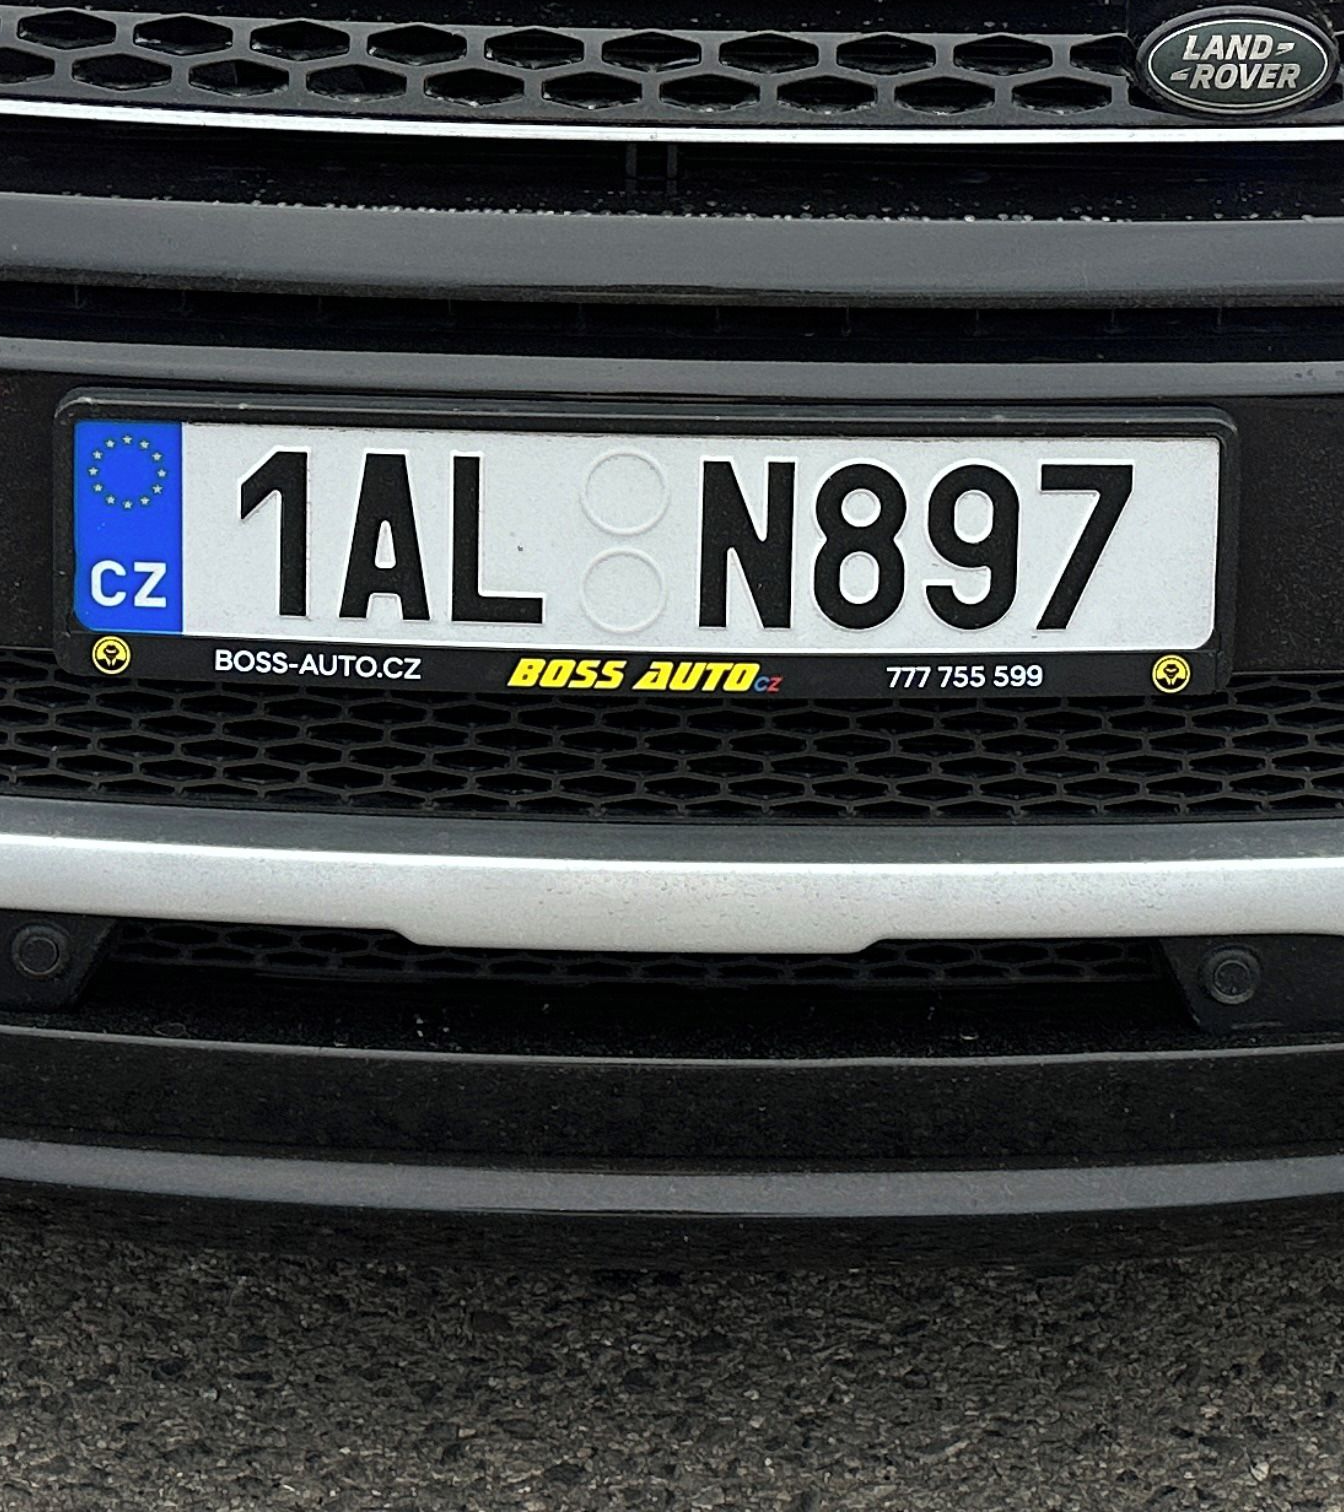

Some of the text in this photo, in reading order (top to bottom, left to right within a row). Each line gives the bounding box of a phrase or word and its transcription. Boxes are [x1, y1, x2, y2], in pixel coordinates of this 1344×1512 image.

[1182, 34, 1274, 61] LAND
[1189, 63, 1302, 89] ROVER
[240, 450, 1134, 631] 1AL N897
[90, 560, 167, 608] CZ
[214, 649, 422, 680] BOSS-AUTO.CZ
[507, 657, 628, 689] BOSS
[632, 661, 761, 692] AUTO
[886, 664, 1044, 688] 777 755 599
